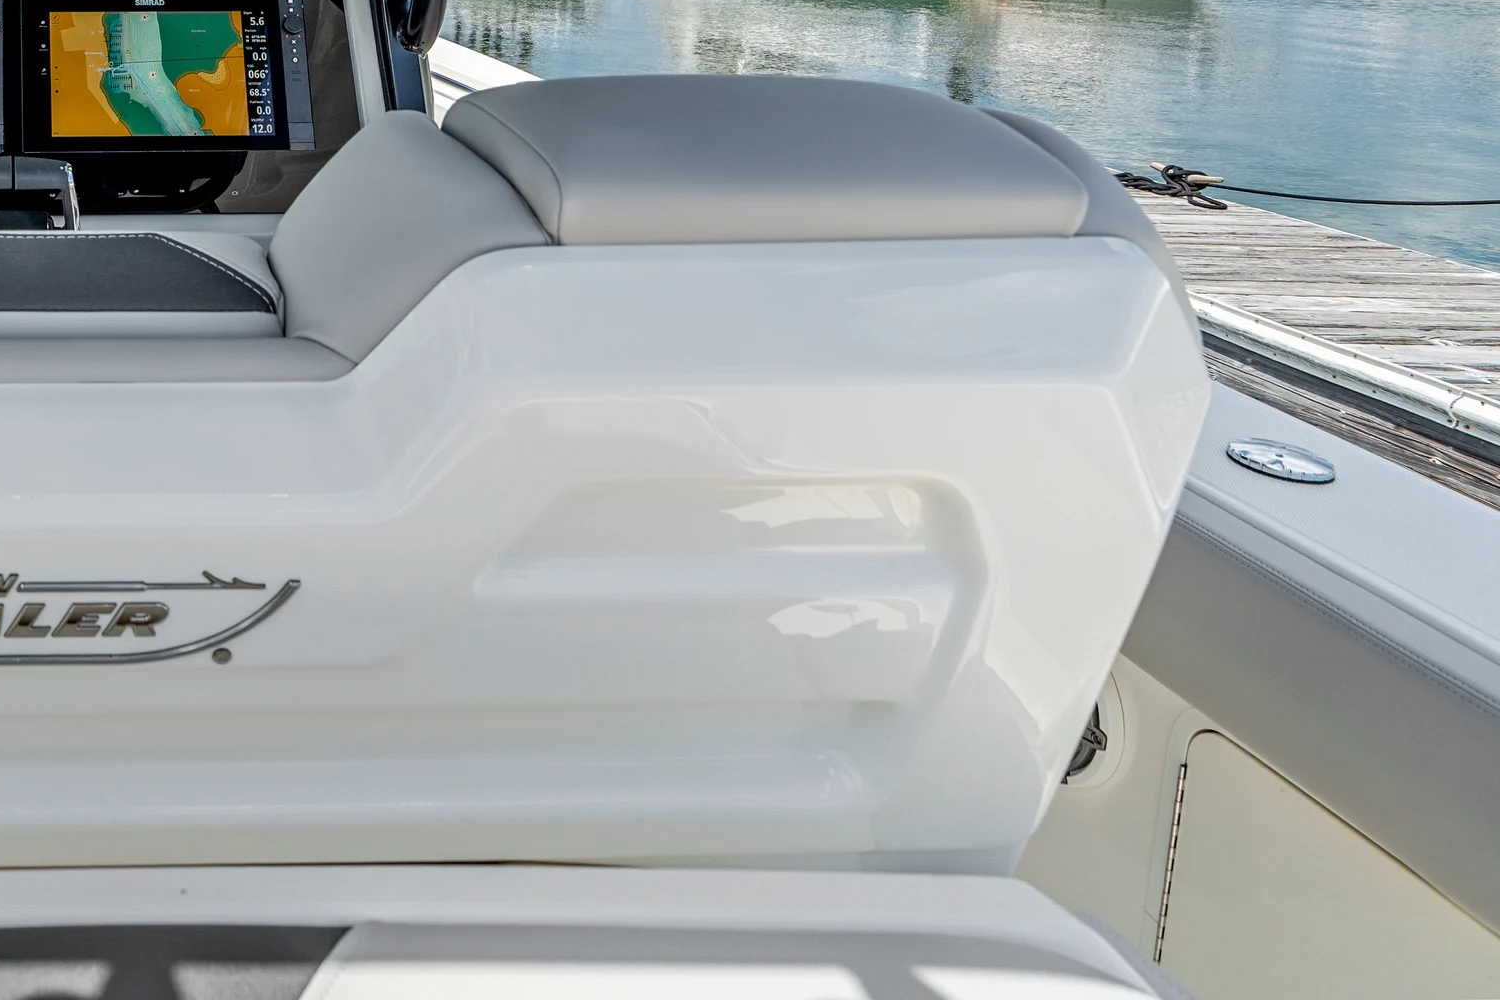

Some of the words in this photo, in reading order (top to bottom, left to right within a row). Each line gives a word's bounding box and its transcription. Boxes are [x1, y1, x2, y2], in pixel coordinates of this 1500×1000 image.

[250, 17, 265, 26] 5.6
[252, 52, 267, 61] 0.0
[248, 70, 268, 78] 066°
[249, 88, 270, 96] 68.5°
[256, 106, 271, 115] 0.0
[252, 124, 273, 133] 12.0
